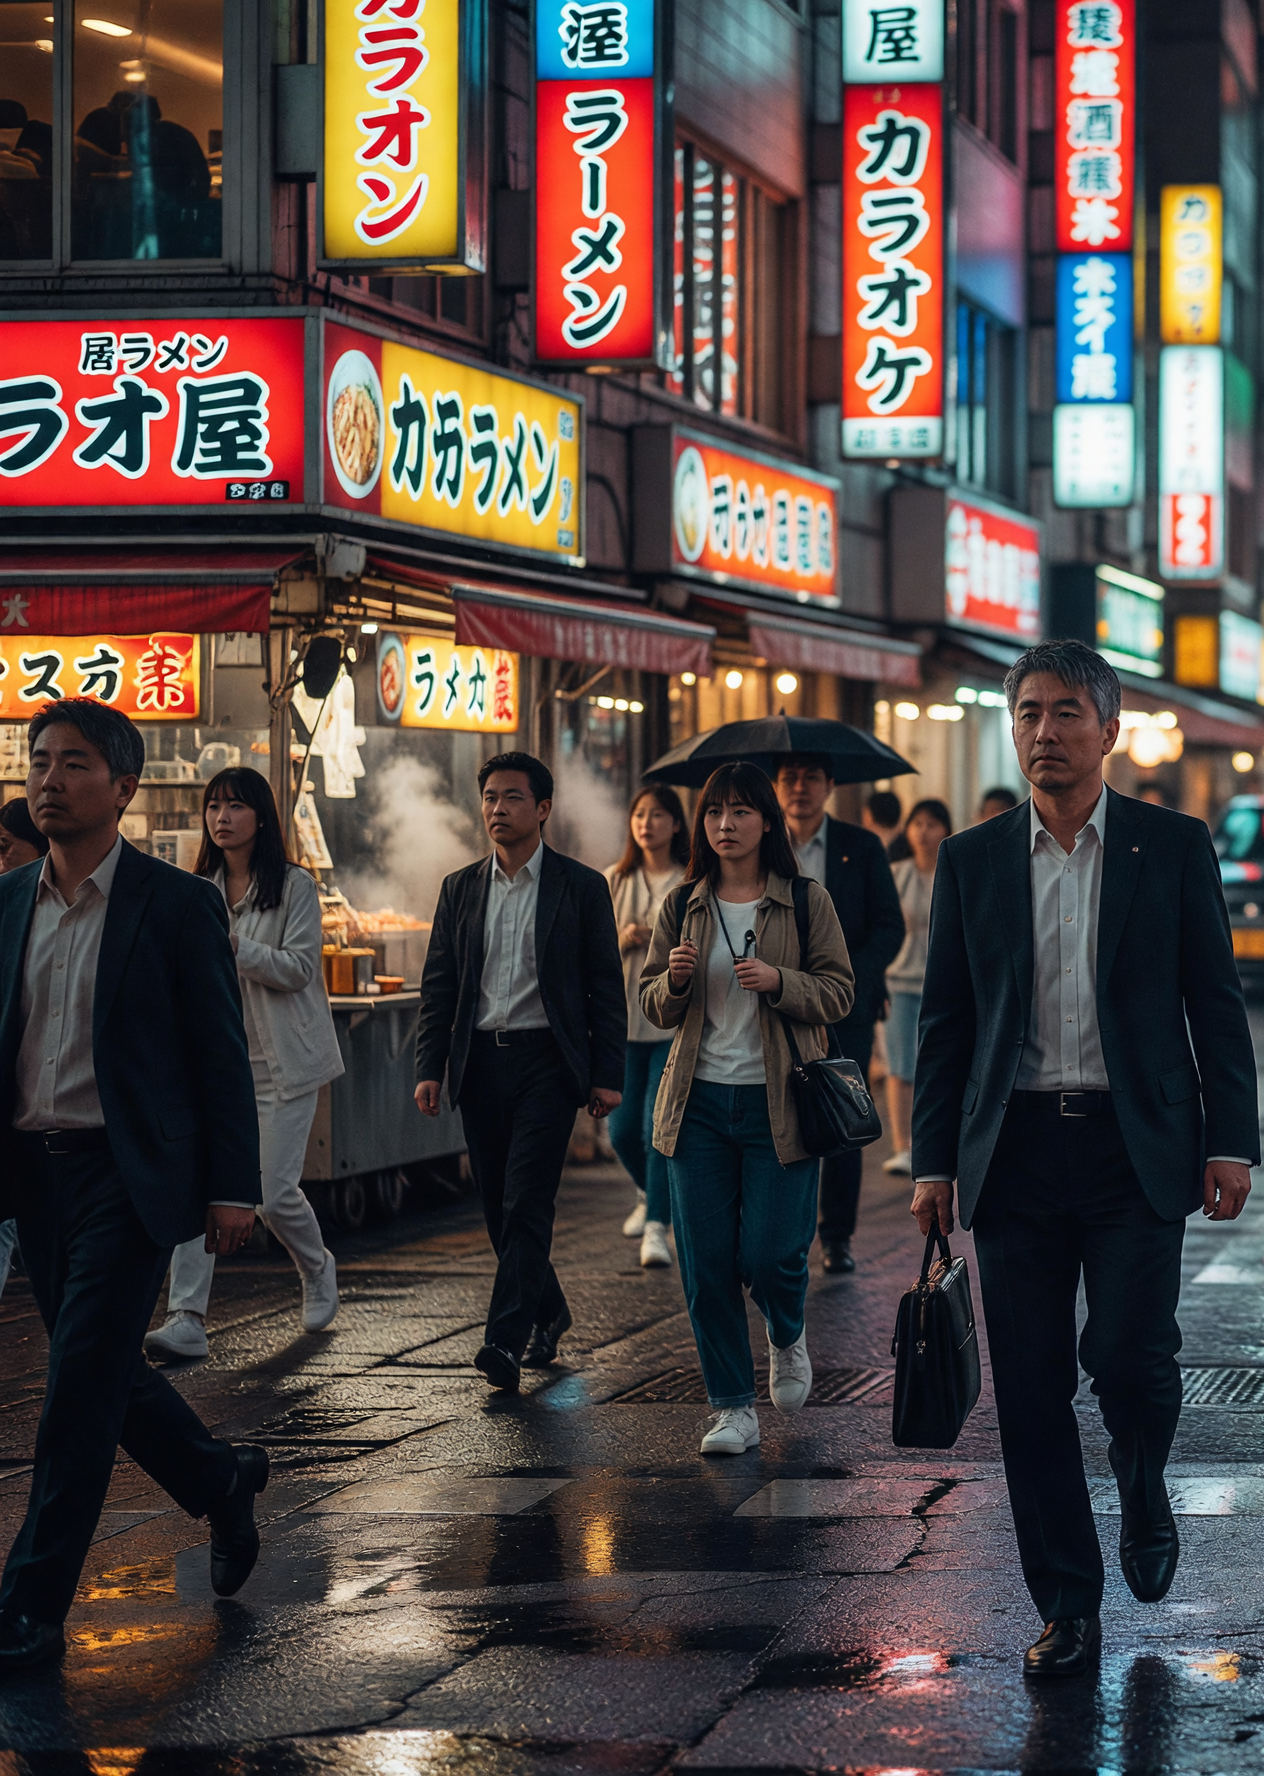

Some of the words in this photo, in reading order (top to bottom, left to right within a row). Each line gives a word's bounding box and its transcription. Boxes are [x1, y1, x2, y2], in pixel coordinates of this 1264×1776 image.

[358, 0, 427, 242] ラオン
[866, 7, 919, 63] 屋
[566, 93, 625, 344] ラーメン
[861, 113, 928, 409] カラオケ
